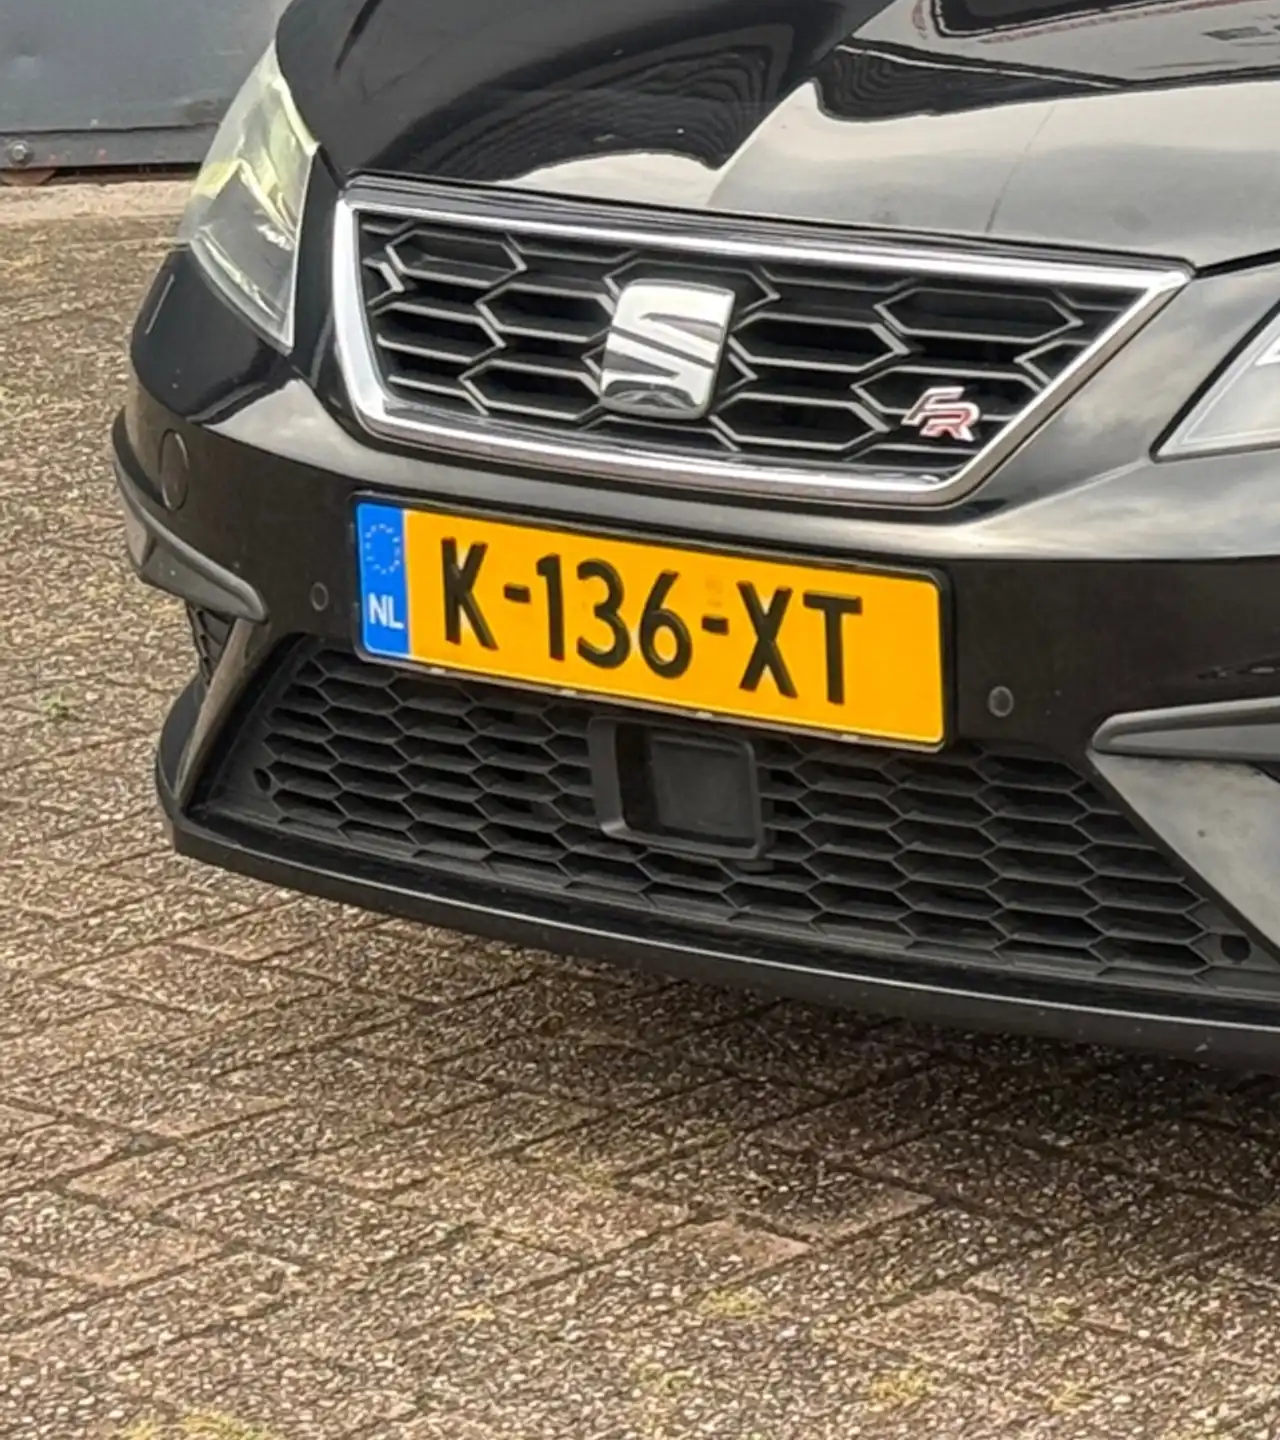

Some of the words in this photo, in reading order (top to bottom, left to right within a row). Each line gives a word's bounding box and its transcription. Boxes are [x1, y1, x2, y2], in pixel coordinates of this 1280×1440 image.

[901, 386, 980, 442] FR
[368, 592, 405, 630] NL
[440, 536, 863, 706] K-136-XT
